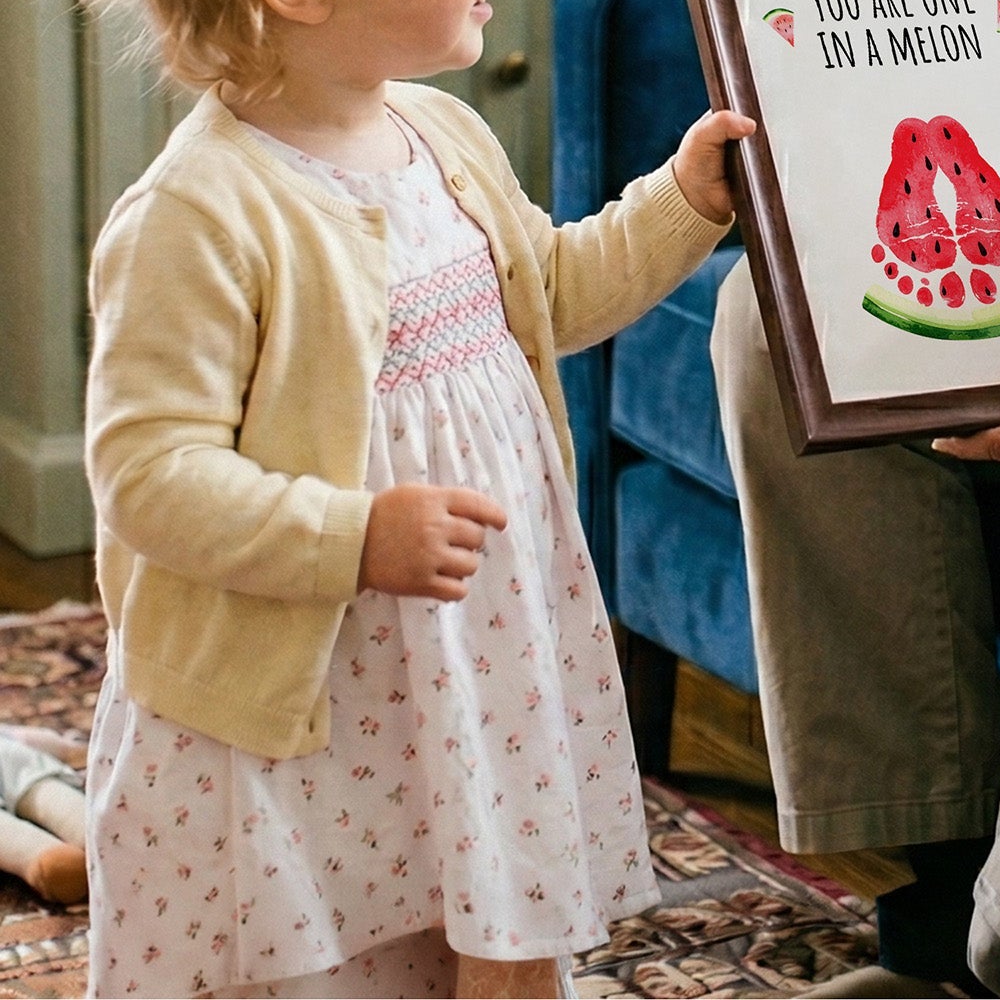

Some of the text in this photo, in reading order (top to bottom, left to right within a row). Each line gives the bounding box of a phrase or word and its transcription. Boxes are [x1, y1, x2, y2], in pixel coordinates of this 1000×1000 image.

[817, 23, 983, 69] IN A MELON
